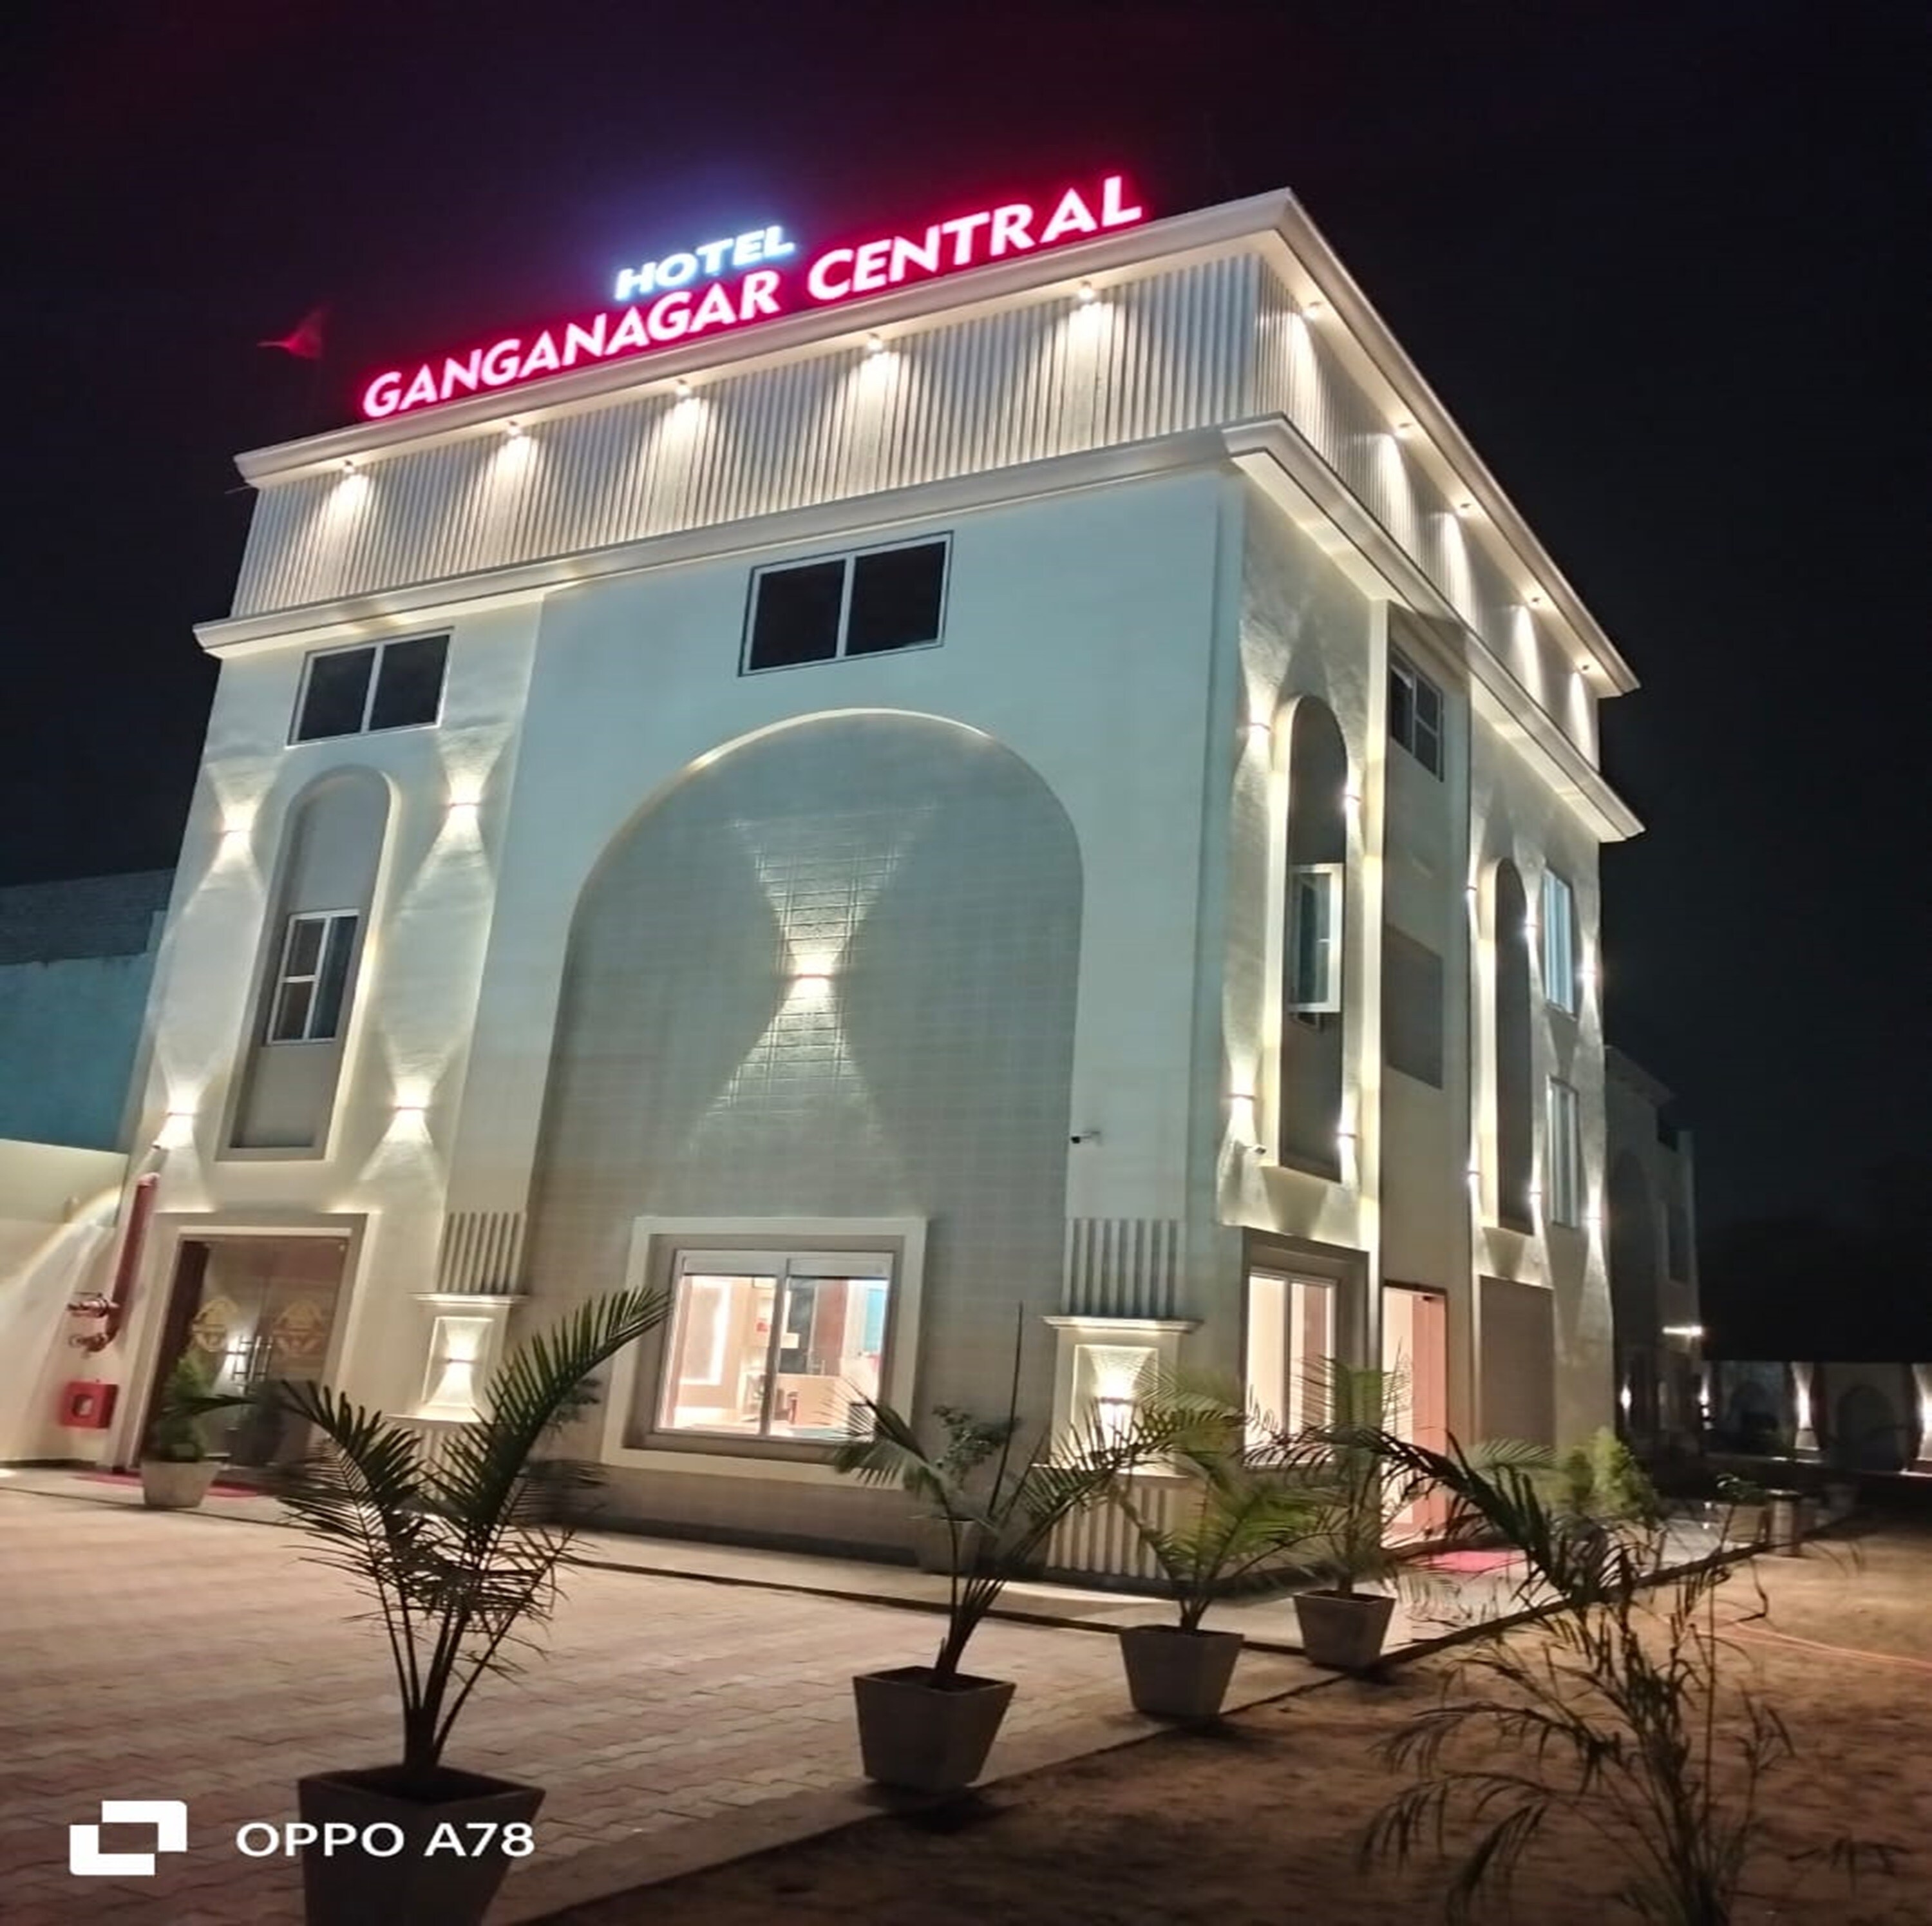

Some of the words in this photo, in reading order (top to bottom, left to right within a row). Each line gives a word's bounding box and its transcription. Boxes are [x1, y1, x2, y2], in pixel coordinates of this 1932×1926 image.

[363, 270, 781, 419] GANGANAGAR
[807, 175, 1142, 300] CENTRAL
[615, 225, 794, 301] HOTEL
